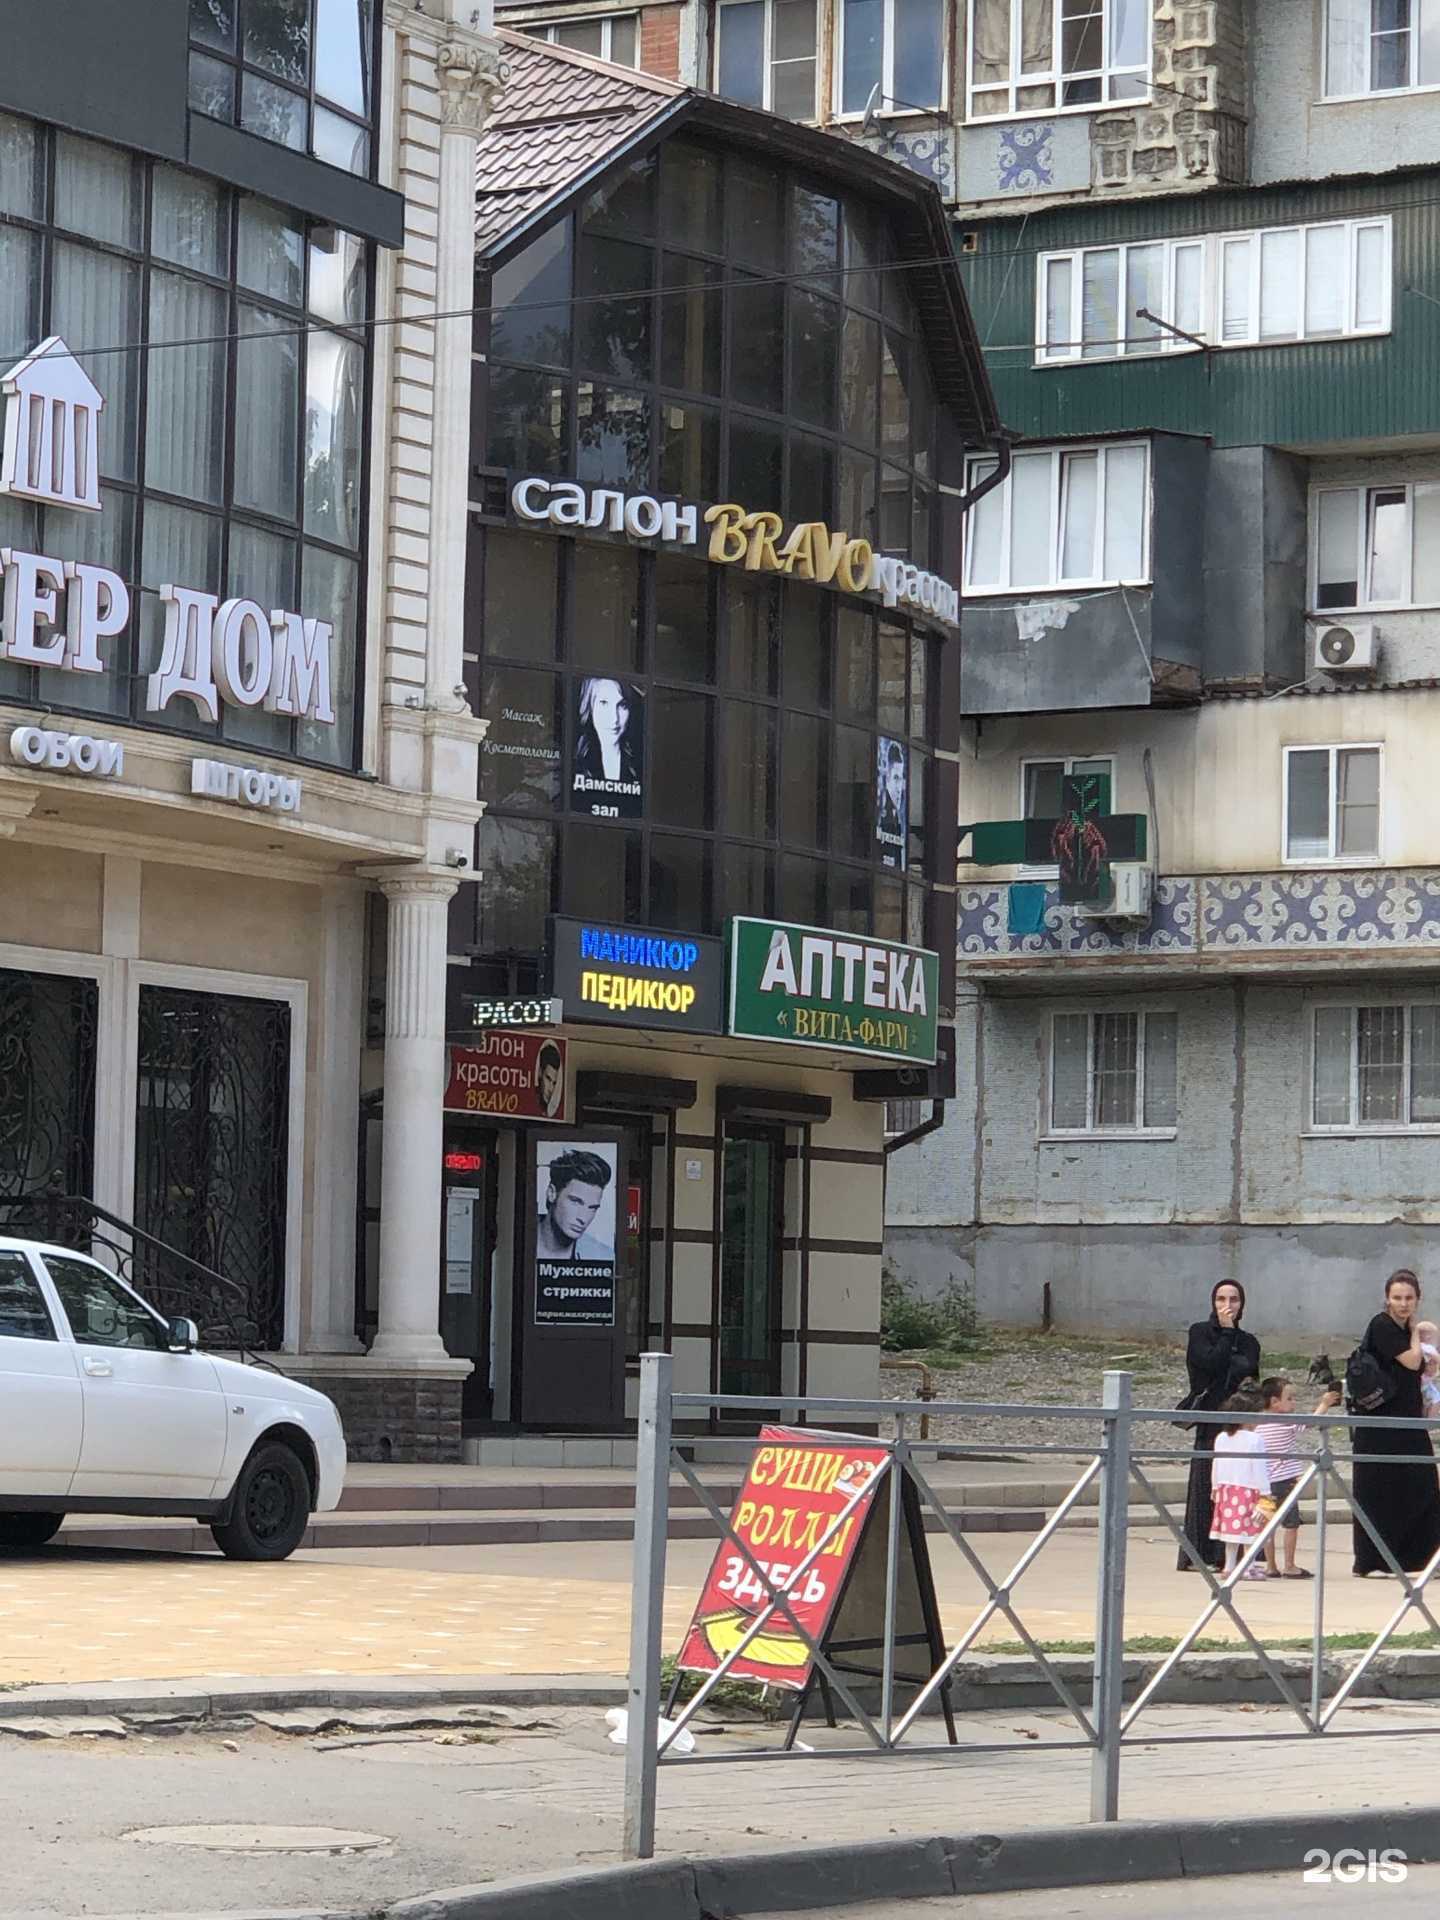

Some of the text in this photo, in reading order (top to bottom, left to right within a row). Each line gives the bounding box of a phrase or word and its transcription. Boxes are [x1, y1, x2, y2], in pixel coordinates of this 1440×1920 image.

[512, 478, 697, 544] салон
[704, 503, 872, 592] BRAVO
[0, 547, 335, 725] ЕР ДОМ
[502, 707, 545, 727] Массаж
[10, 726, 124, 777] ОБОИ
[482, 740, 560, 760] Косметология
[191, 758, 303, 812] ШТОРЫ
[573, 773, 641, 796] Дамский
[591, 804, 619, 818] зал
[580, 927, 698, 972] МАНИКЮР
[760, 929, 928, 1017] АПТЕКА
[581, 971, 696, 1013] ПЕДИКЮР
[465, 1031, 525, 1059] алон
[456, 1062, 532, 1089] красоты
[464, 1089, 519, 1113] BRAVO
[539, 1263, 612, 1279] Мужские
[543, 1287, 612, 1300] стрижки
[751, 1447, 845, 1494] СУШИ
[732, 1500, 855, 1557] РОЛЛЫ
